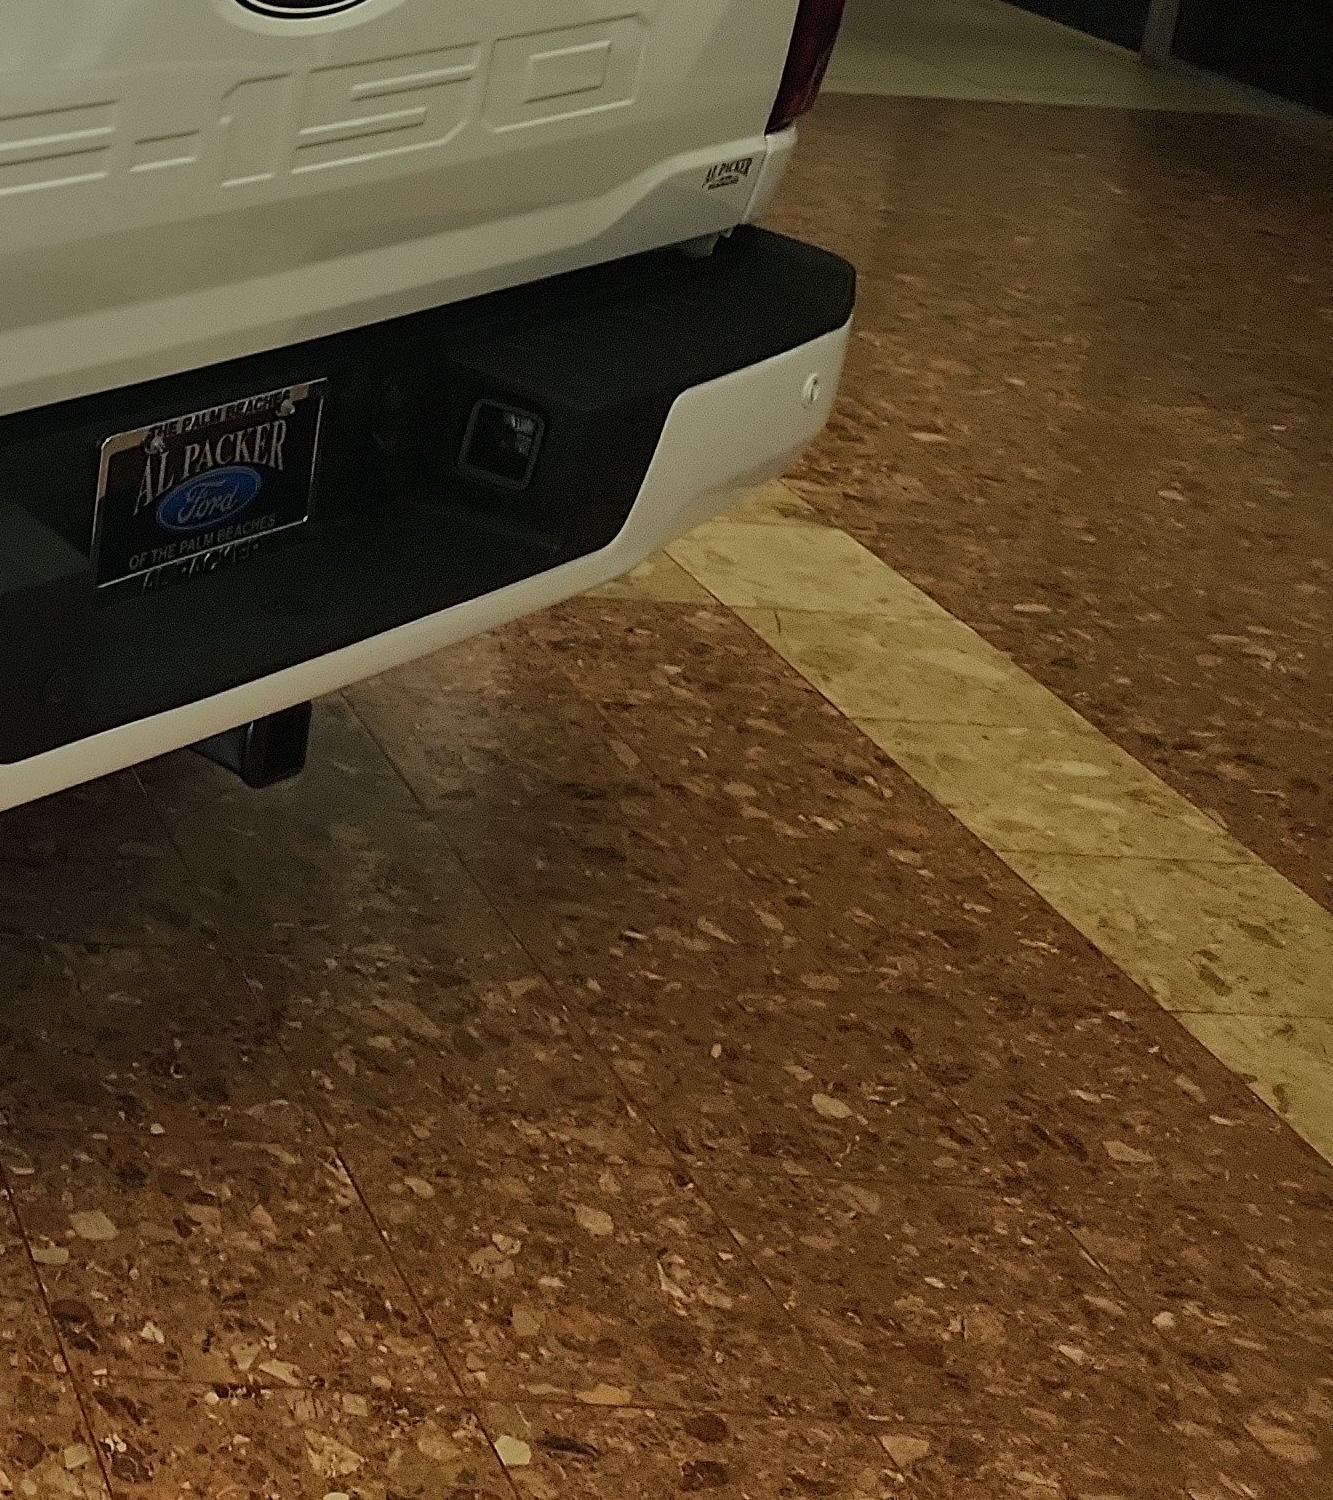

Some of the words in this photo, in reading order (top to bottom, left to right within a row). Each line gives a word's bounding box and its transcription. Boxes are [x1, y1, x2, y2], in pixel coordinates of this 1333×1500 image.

[134, 451, 175, 517] AL
[183, 418, 287, 480] PACKER
[177, 478, 240, 524] Ford
[128, 551, 148, 571] OF
[151, 543, 177, 563] THE
[179, 531, 214, 553] PALM
[216, 513, 276, 544] BEACHES
